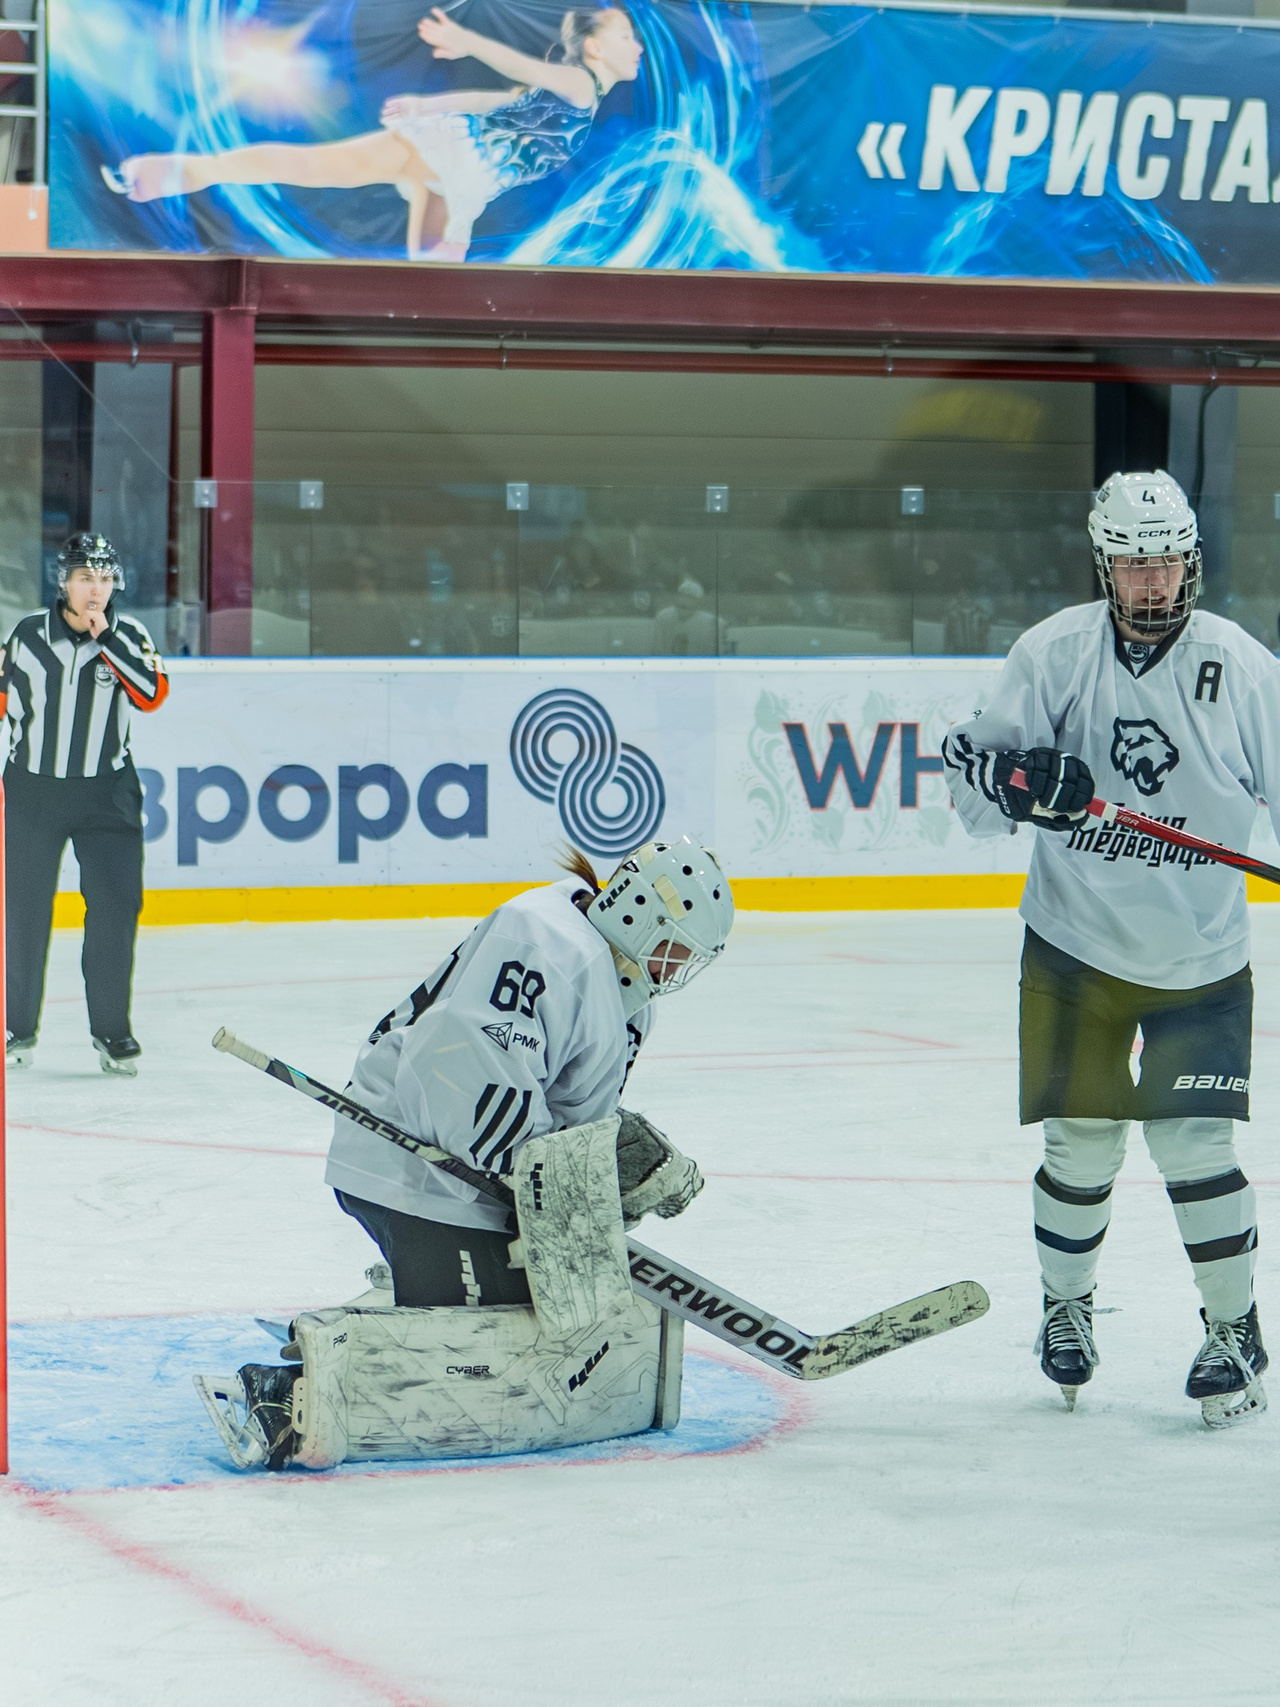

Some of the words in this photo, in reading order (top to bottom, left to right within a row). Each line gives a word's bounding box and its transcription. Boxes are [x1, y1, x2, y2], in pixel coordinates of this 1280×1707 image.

[1142, 490, 1156, 505] 4
[1137, 529, 1172, 539] CCM
[1194, 660, 1223, 704] A
[136, 761, 489, 867] врора
[996, 784, 1011, 815] CCM
[489, 960, 547, 1019] 69
[628, 1250, 813, 1371] ERWOO
[333, 1332, 348, 1349] PRO
[446, 1365, 490, 1375] CYBER
